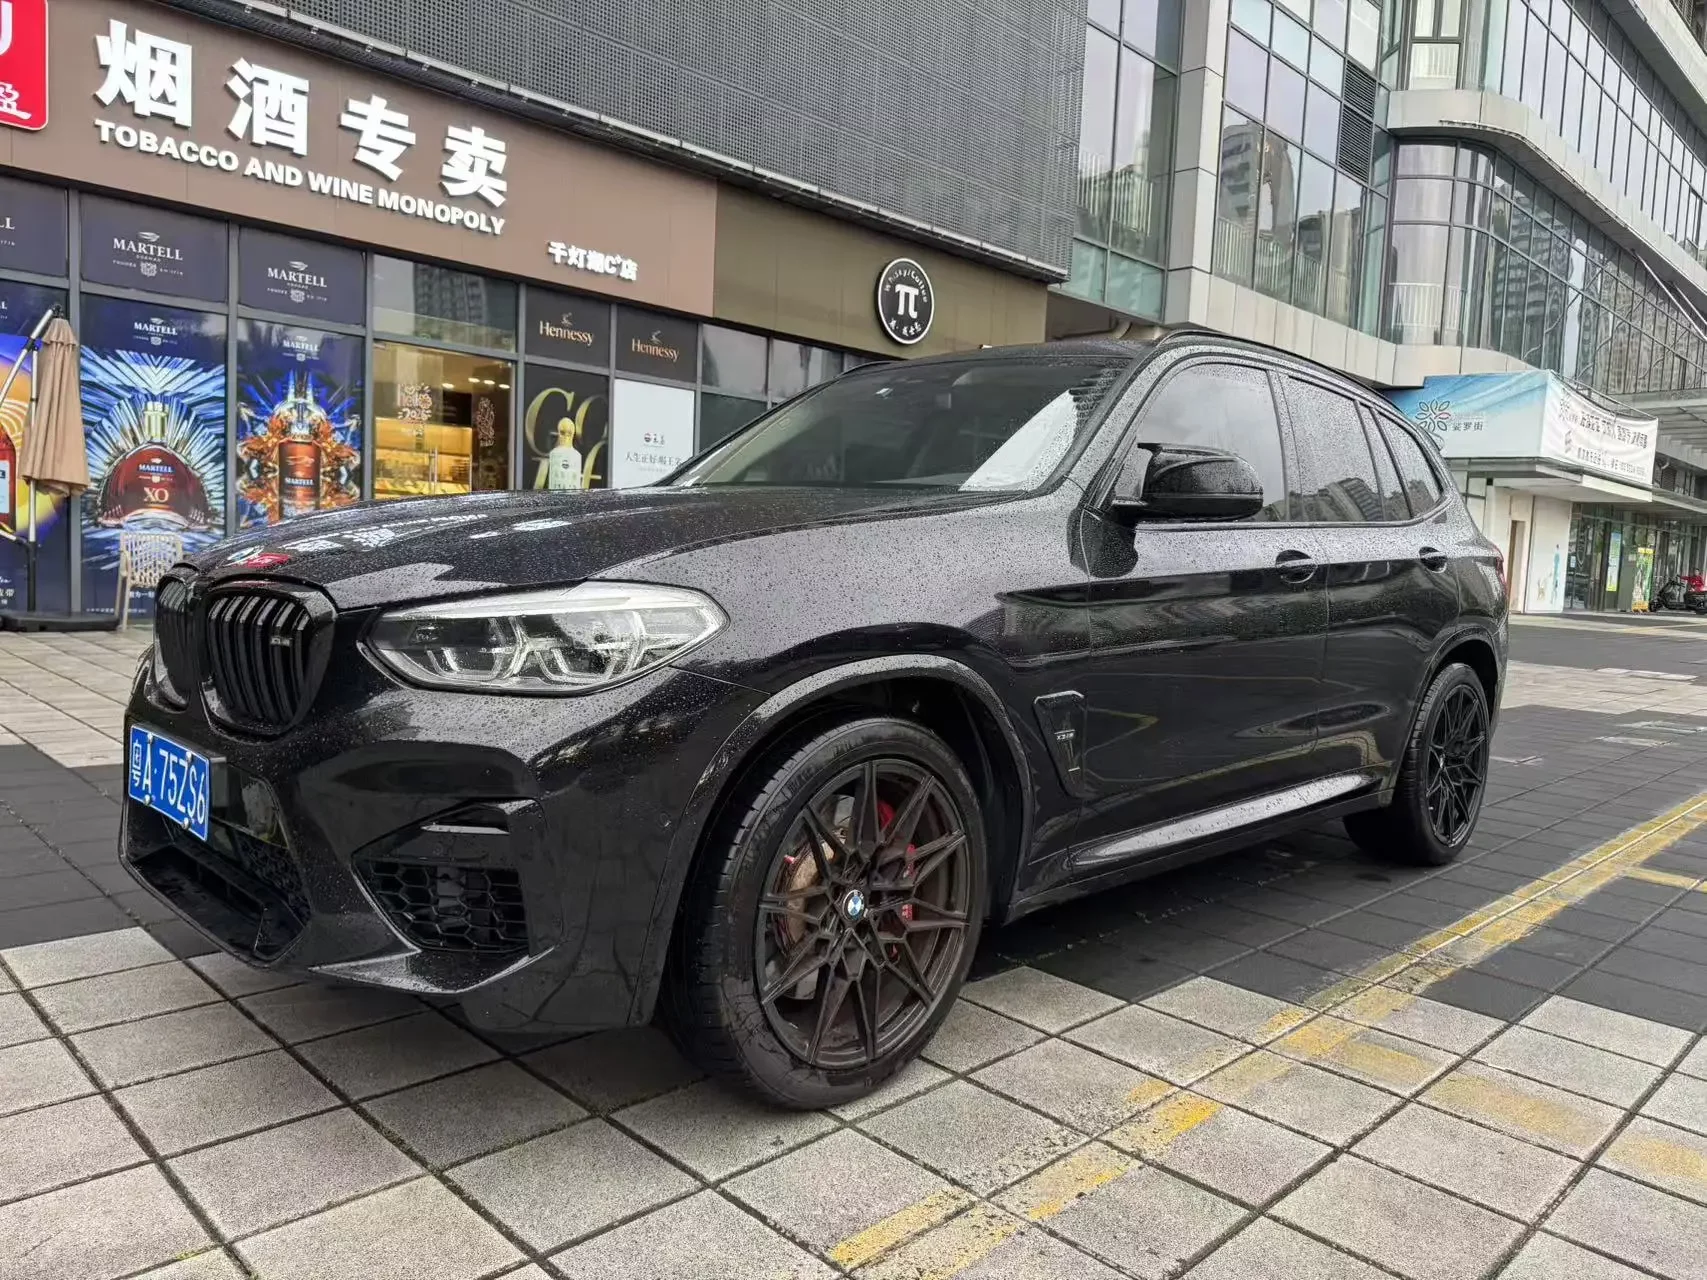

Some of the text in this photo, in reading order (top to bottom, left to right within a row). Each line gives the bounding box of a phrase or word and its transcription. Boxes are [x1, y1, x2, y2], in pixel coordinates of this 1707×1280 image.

[94, 19, 507, 207] 烟酒专卖
[94, 119, 505, 235] TOBACCO AND WINE MONOPOLY
[113, 237, 183, 261] MARTELL
[268, 267, 328, 288] MARTELL
[134, 322, 178, 336] MARTELL
[540, 321, 593, 347] Hennessy
[632, 338, 679, 362] Hennessy
[144, 487, 169, 502] XO
